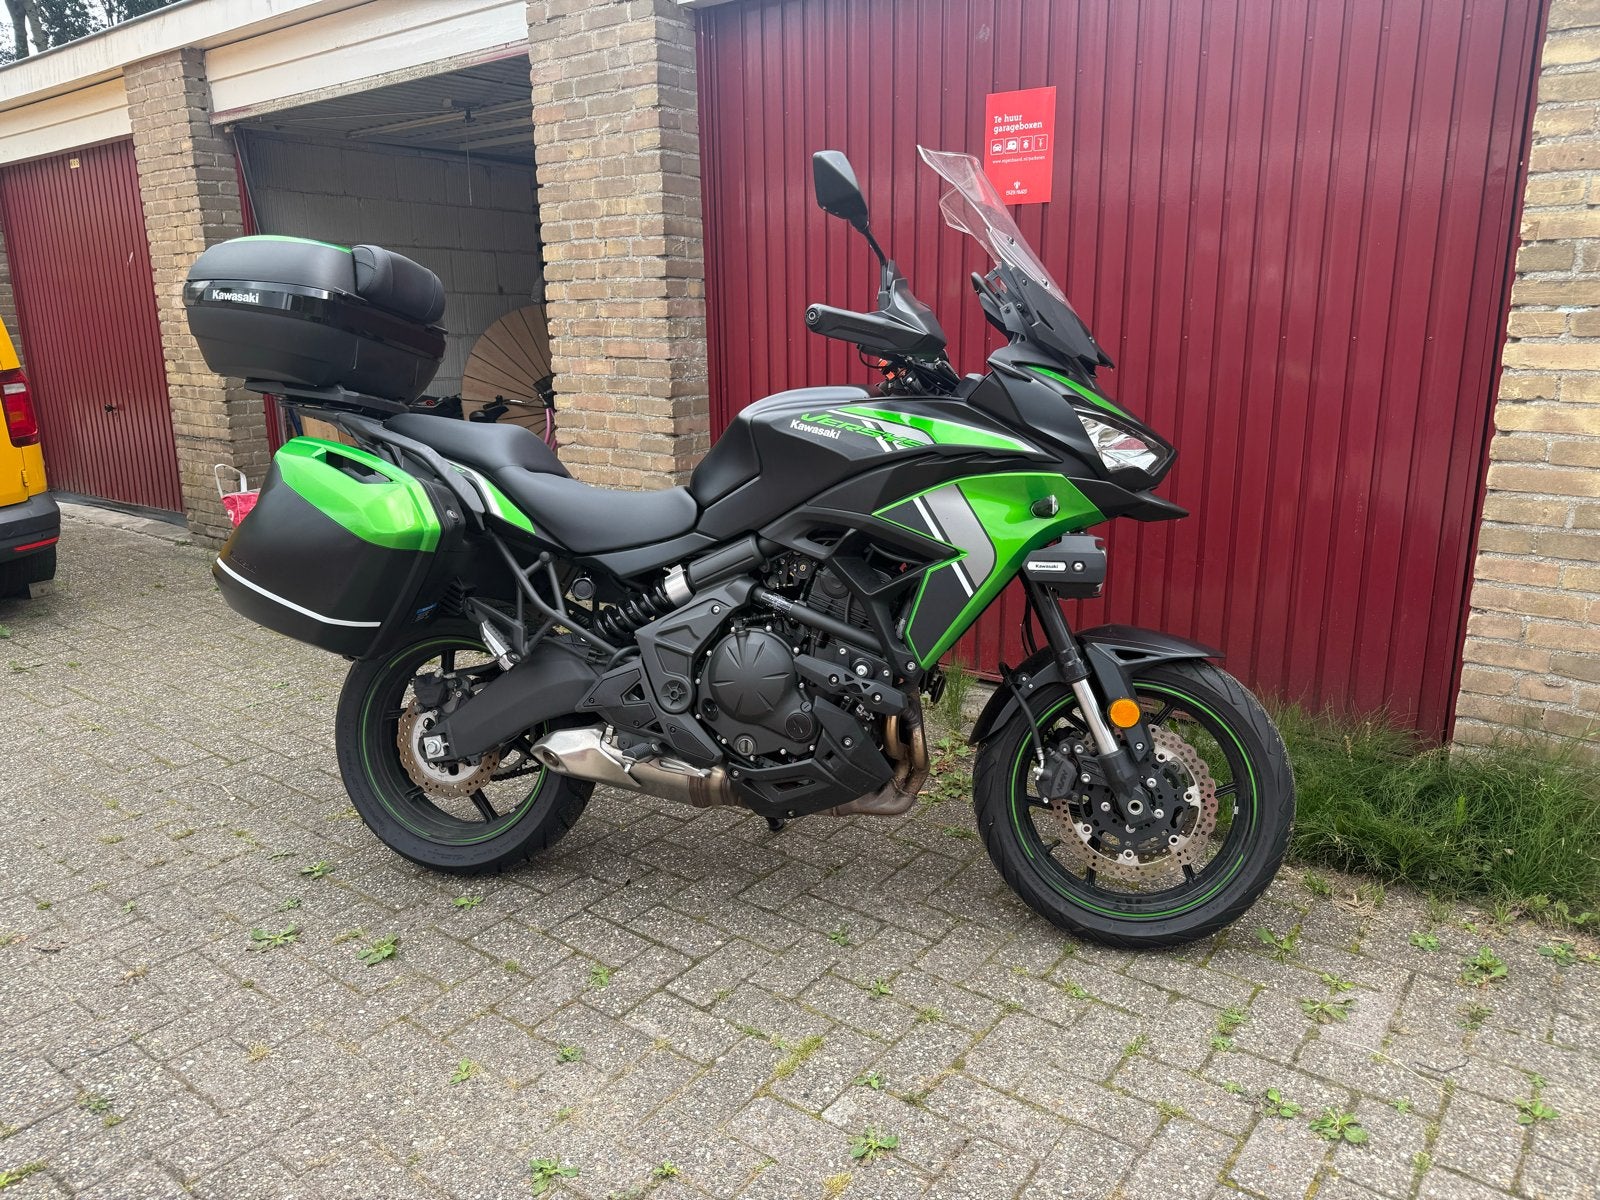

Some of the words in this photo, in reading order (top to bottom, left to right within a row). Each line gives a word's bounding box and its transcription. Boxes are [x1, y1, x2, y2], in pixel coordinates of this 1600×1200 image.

[994, 115, 1002, 123] Te
[1004, 114, 1022, 122] huur
[993, 121, 1042, 134] garageboxen
[212, 289, 259, 303] Kawasaki
[790, 420, 841, 439] Kawasaki
[801, 413, 925, 448] VERSYS
